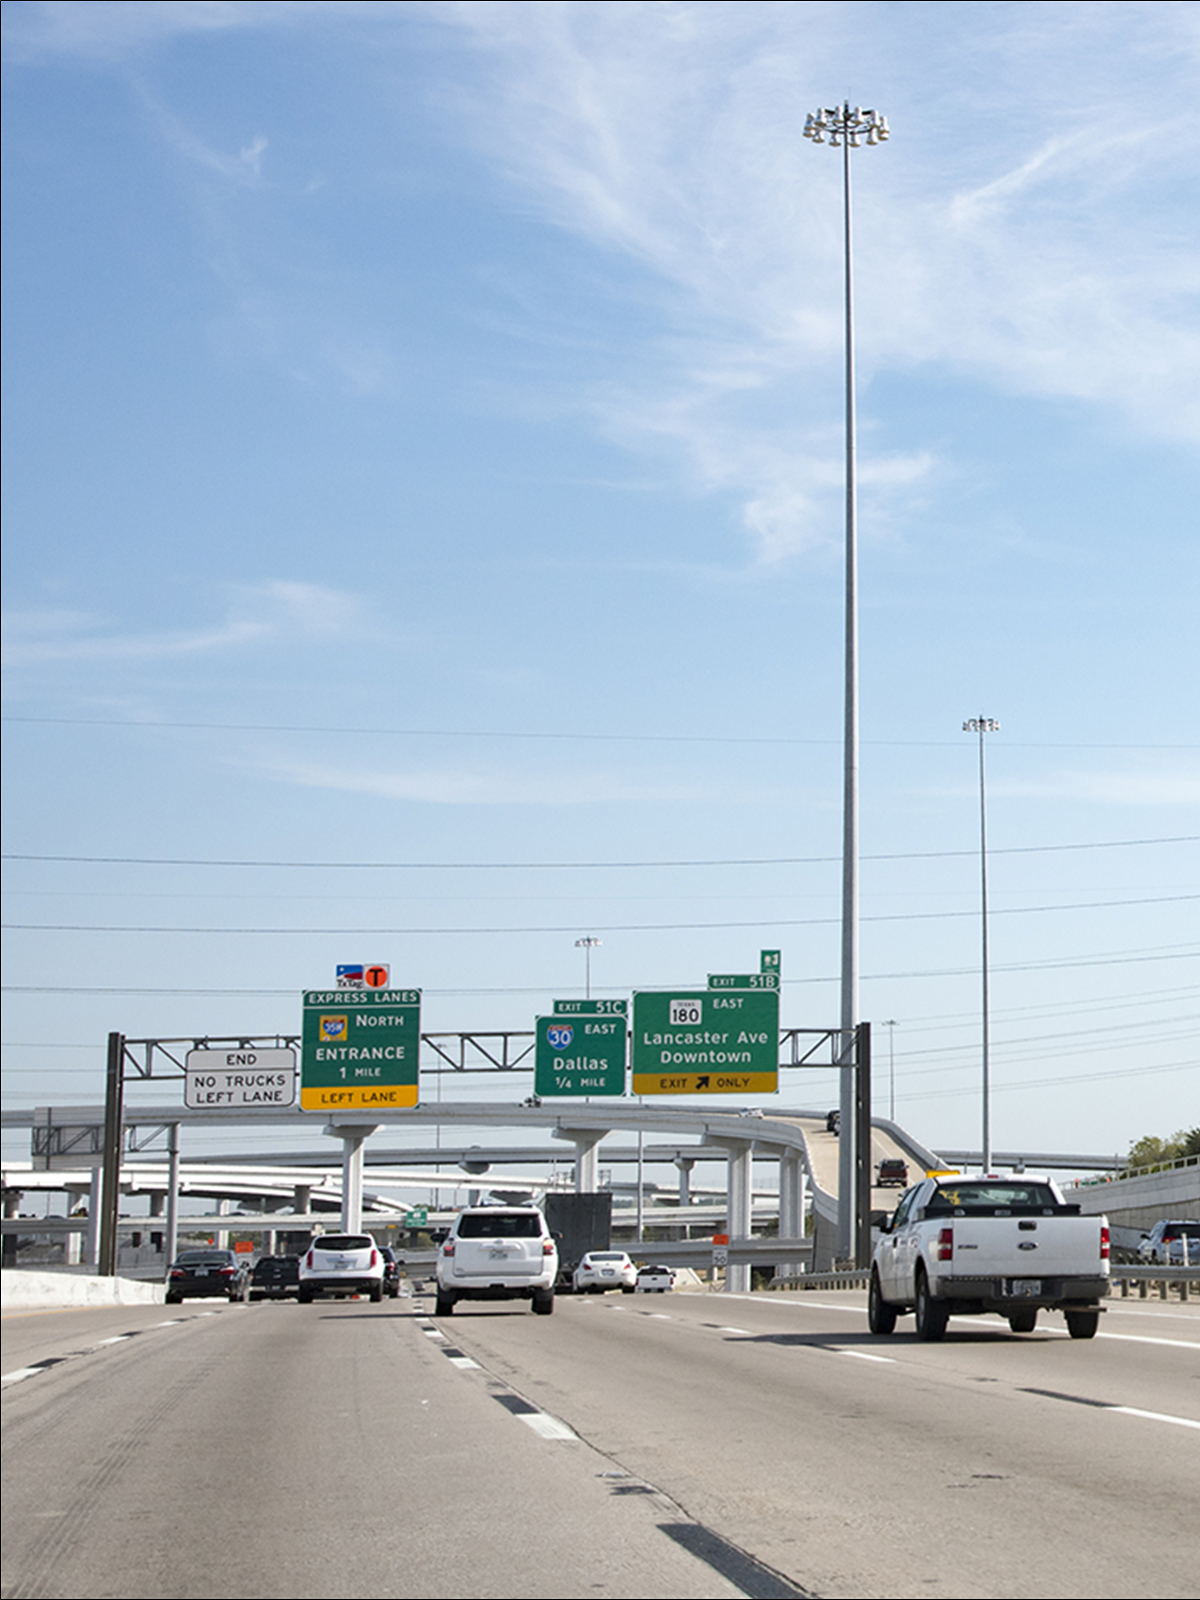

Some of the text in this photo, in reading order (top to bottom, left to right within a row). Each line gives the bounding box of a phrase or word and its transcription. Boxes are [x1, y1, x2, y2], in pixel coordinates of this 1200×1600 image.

[713, 975, 775, 988] EXIT 51B
[309, 991, 417, 1004] EXPRESS LANES
[713, 998, 744, 1009] EAST
[558, 1001, 623, 1013] EXIT 51C
[356, 1014, 404, 1027] NORTH
[672, 1008, 699, 1023] 180
[584, 1023, 617, 1035] EAST
[550, 1030, 571, 1045] 30
[643, 1031, 768, 1045] Lancaster Ave
[226, 1053, 257, 1066] END
[315, 1046, 405, 1061] ENTRANCE
[660, 1050, 752, 1064] Downtown
[553, 1056, 608, 1071] Dallas
[339, 1066, 381, 1079] 1 MILE
[194, 1074, 286, 1088] NO TRUCKS
[580, 1077, 606, 1087] MILE
[660, 1077, 751, 1089] EXIT ONLY
[196, 1090, 283, 1104] LEFT LANE
[321, 1091, 397, 1104] LEFT LANE
